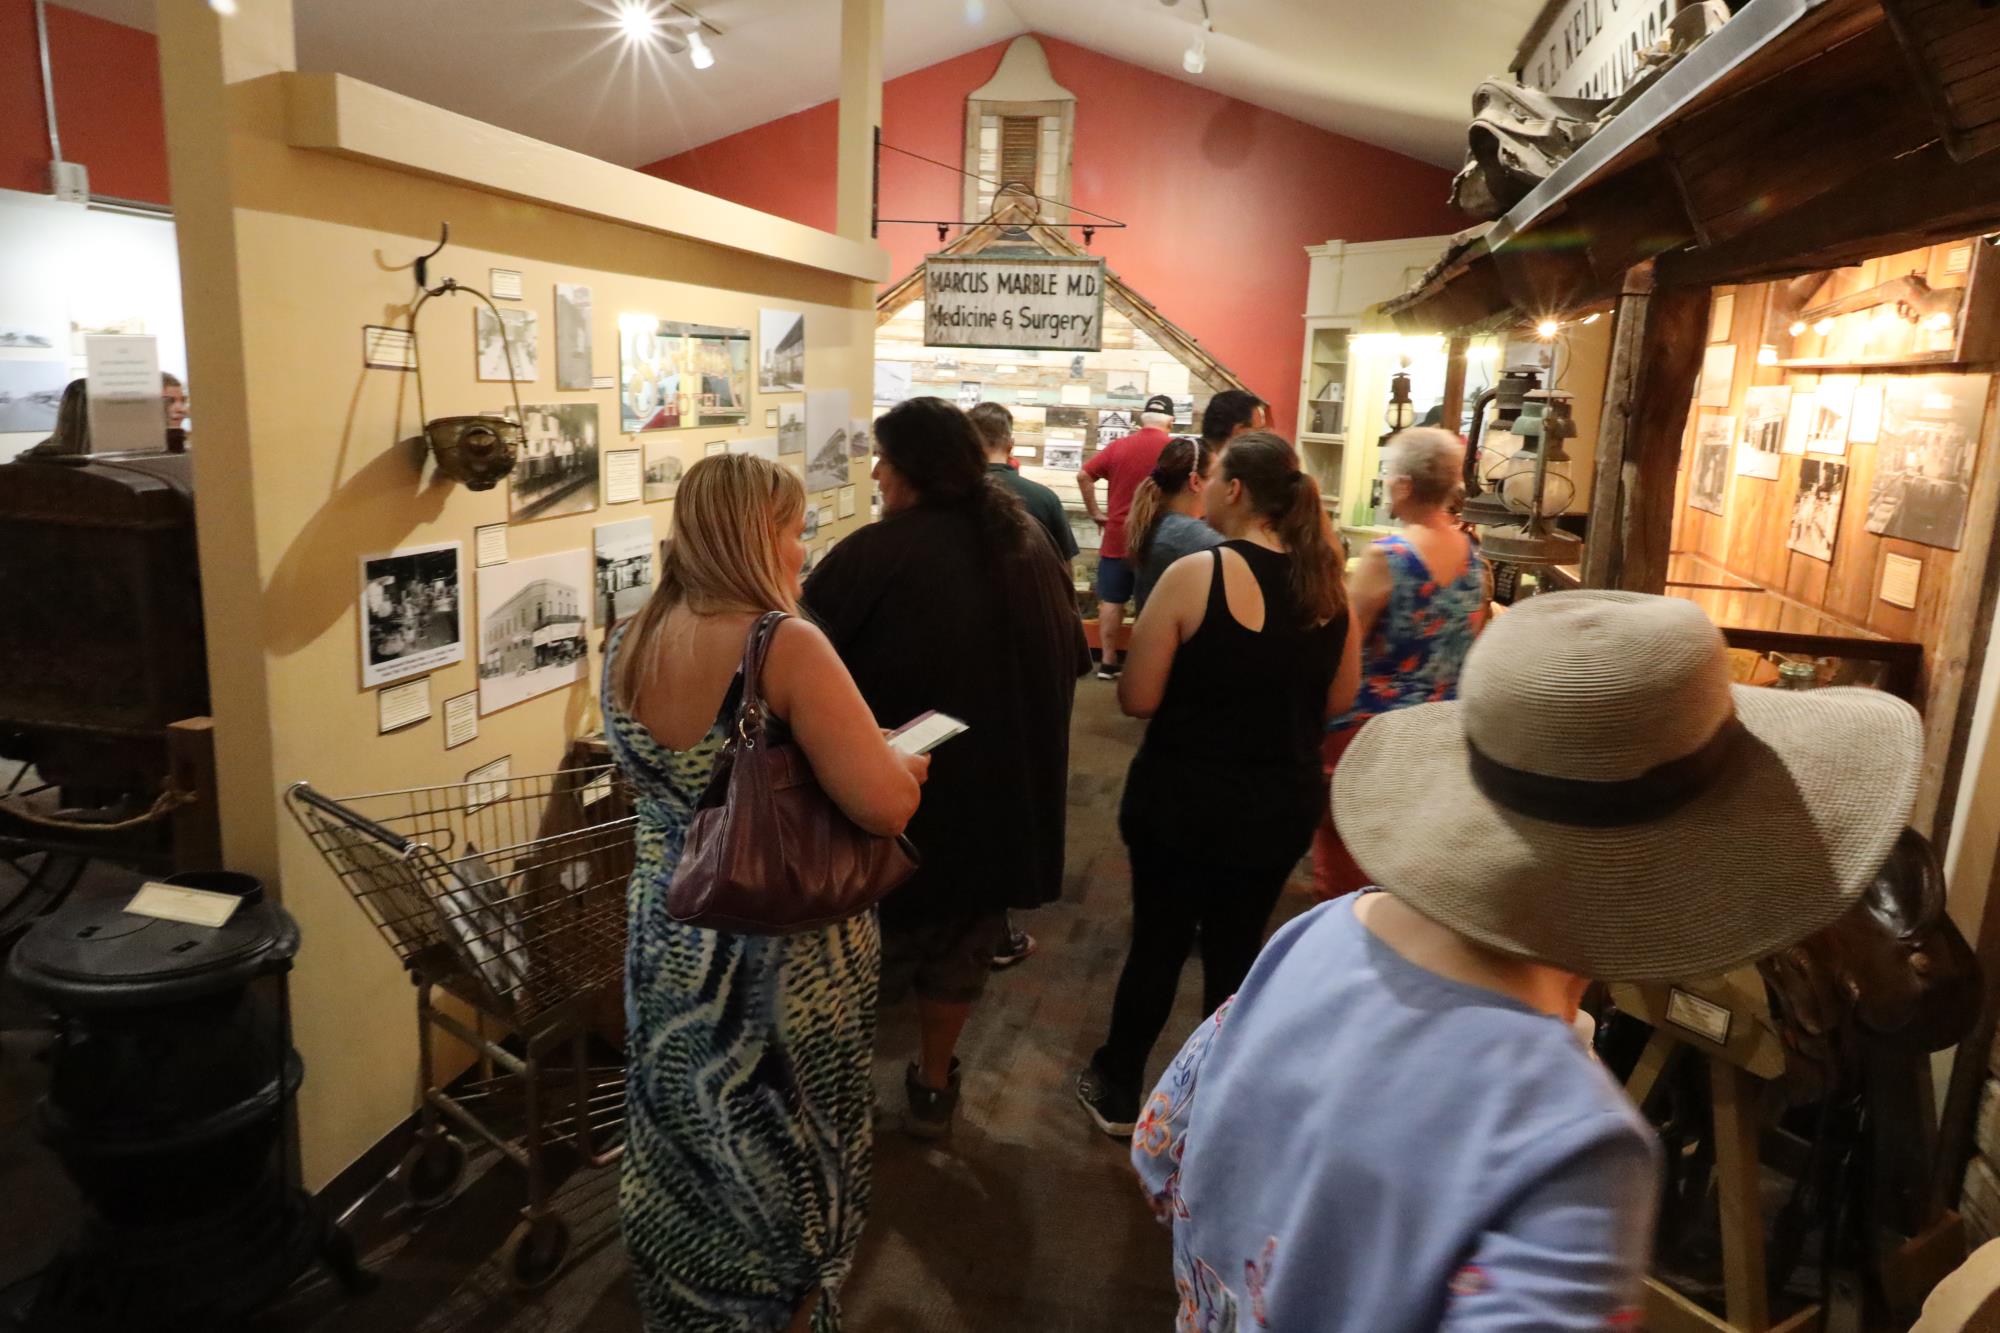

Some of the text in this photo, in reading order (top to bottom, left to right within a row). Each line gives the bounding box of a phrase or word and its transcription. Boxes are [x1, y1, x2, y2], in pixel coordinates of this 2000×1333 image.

[930, 271, 1099, 297] MARCUS MARBLE M.D.
[930, 305, 1093, 338] Medicine & Surgery
